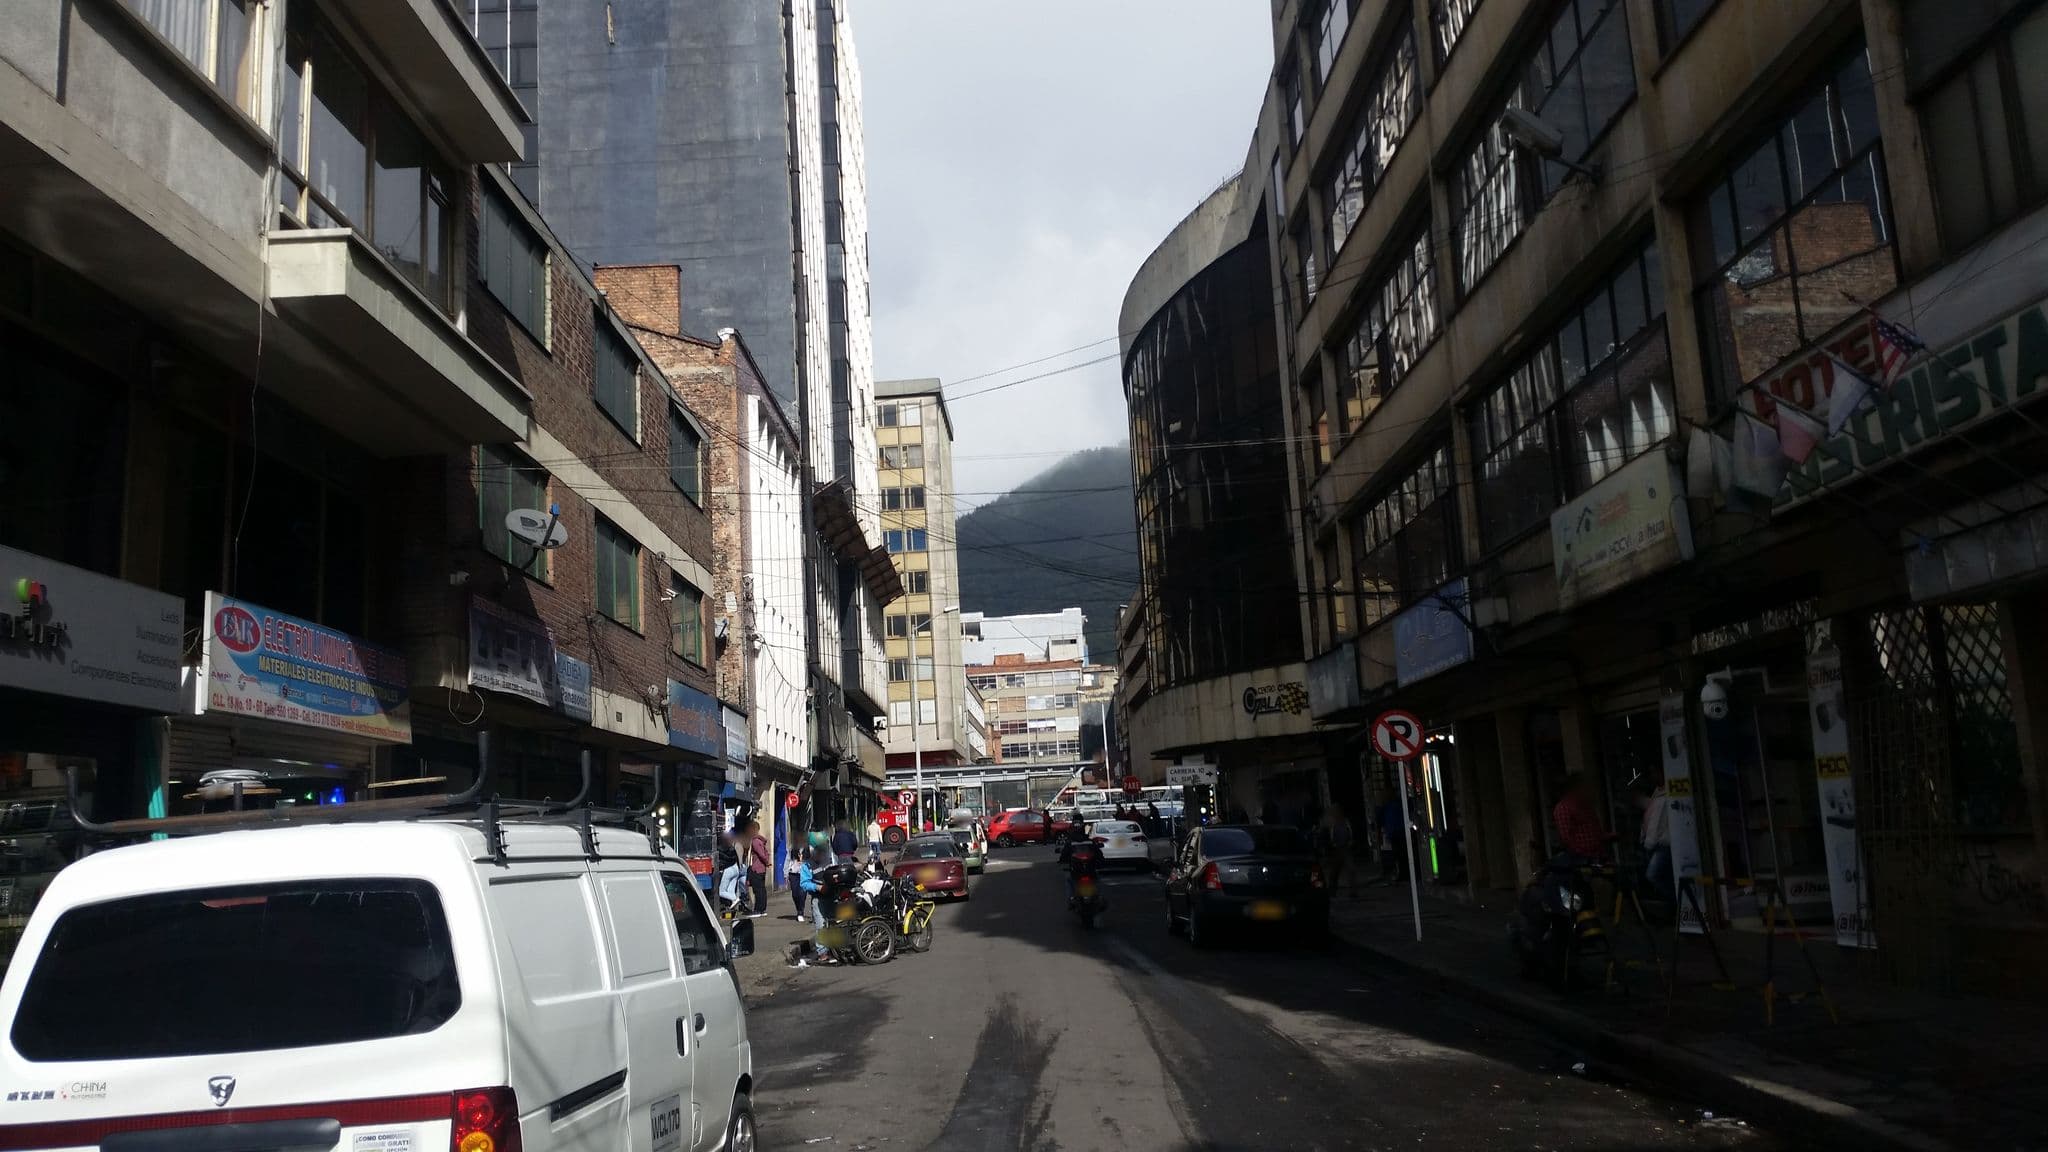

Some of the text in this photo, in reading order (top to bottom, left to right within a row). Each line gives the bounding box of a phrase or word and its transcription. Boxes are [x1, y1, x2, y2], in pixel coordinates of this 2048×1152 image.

[259, 655, 305, 681] MATERIALES
[307, 667, 349, 692] ELECTRICOS
[1124, 782, 1140, 790] PARE
[71, 1081, 107, 1093] CHINA
[651, 1107, 681, 1141] WCL170
